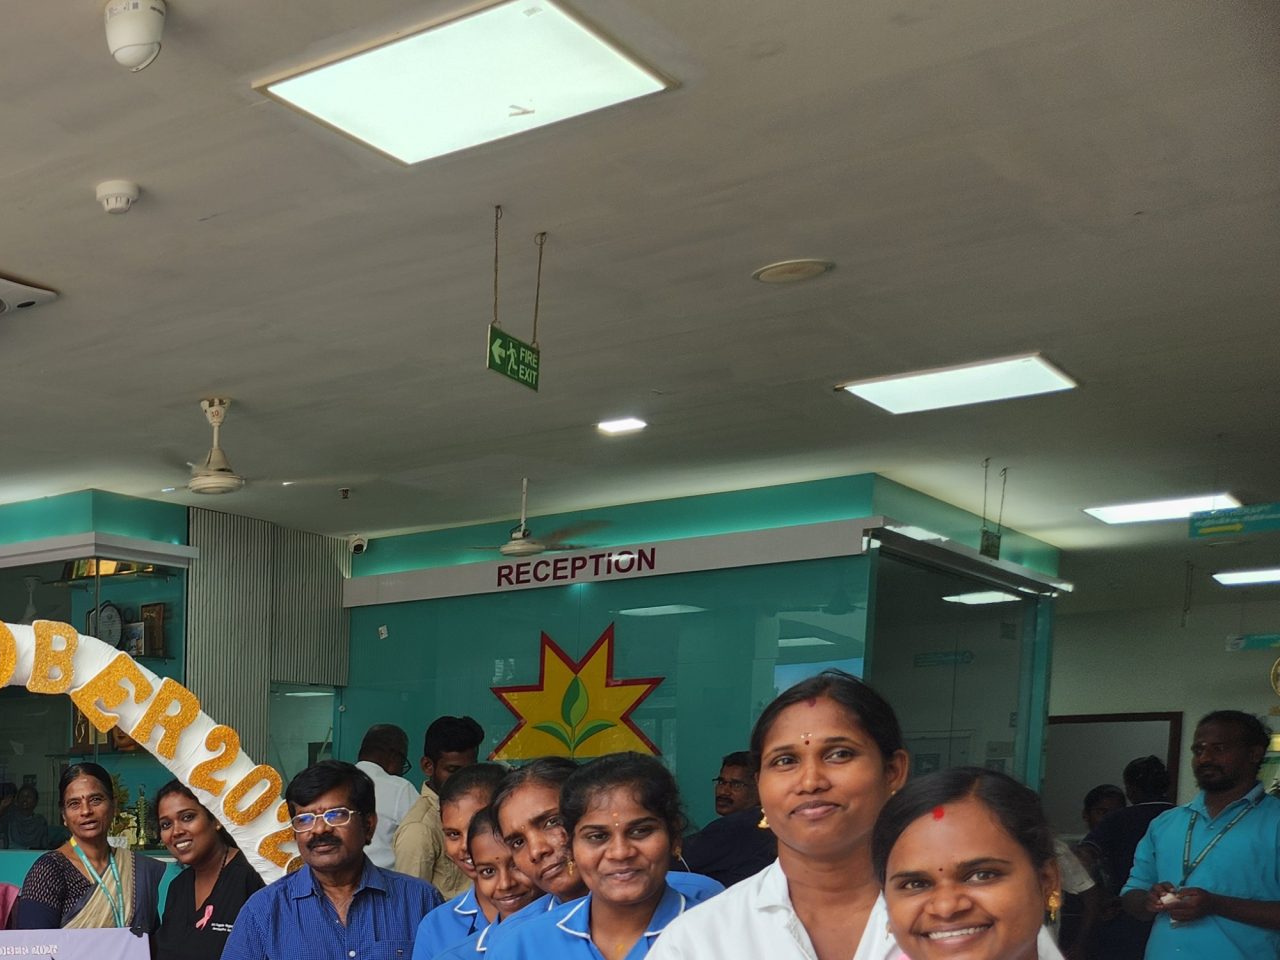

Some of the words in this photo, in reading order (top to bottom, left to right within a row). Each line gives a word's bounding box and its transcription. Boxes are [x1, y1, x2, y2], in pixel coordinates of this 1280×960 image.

[520, 347, 538, 368] FIRE
[519, 364, 538, 384] EXIT
[496, 547, 656, 587] RECEPTION
